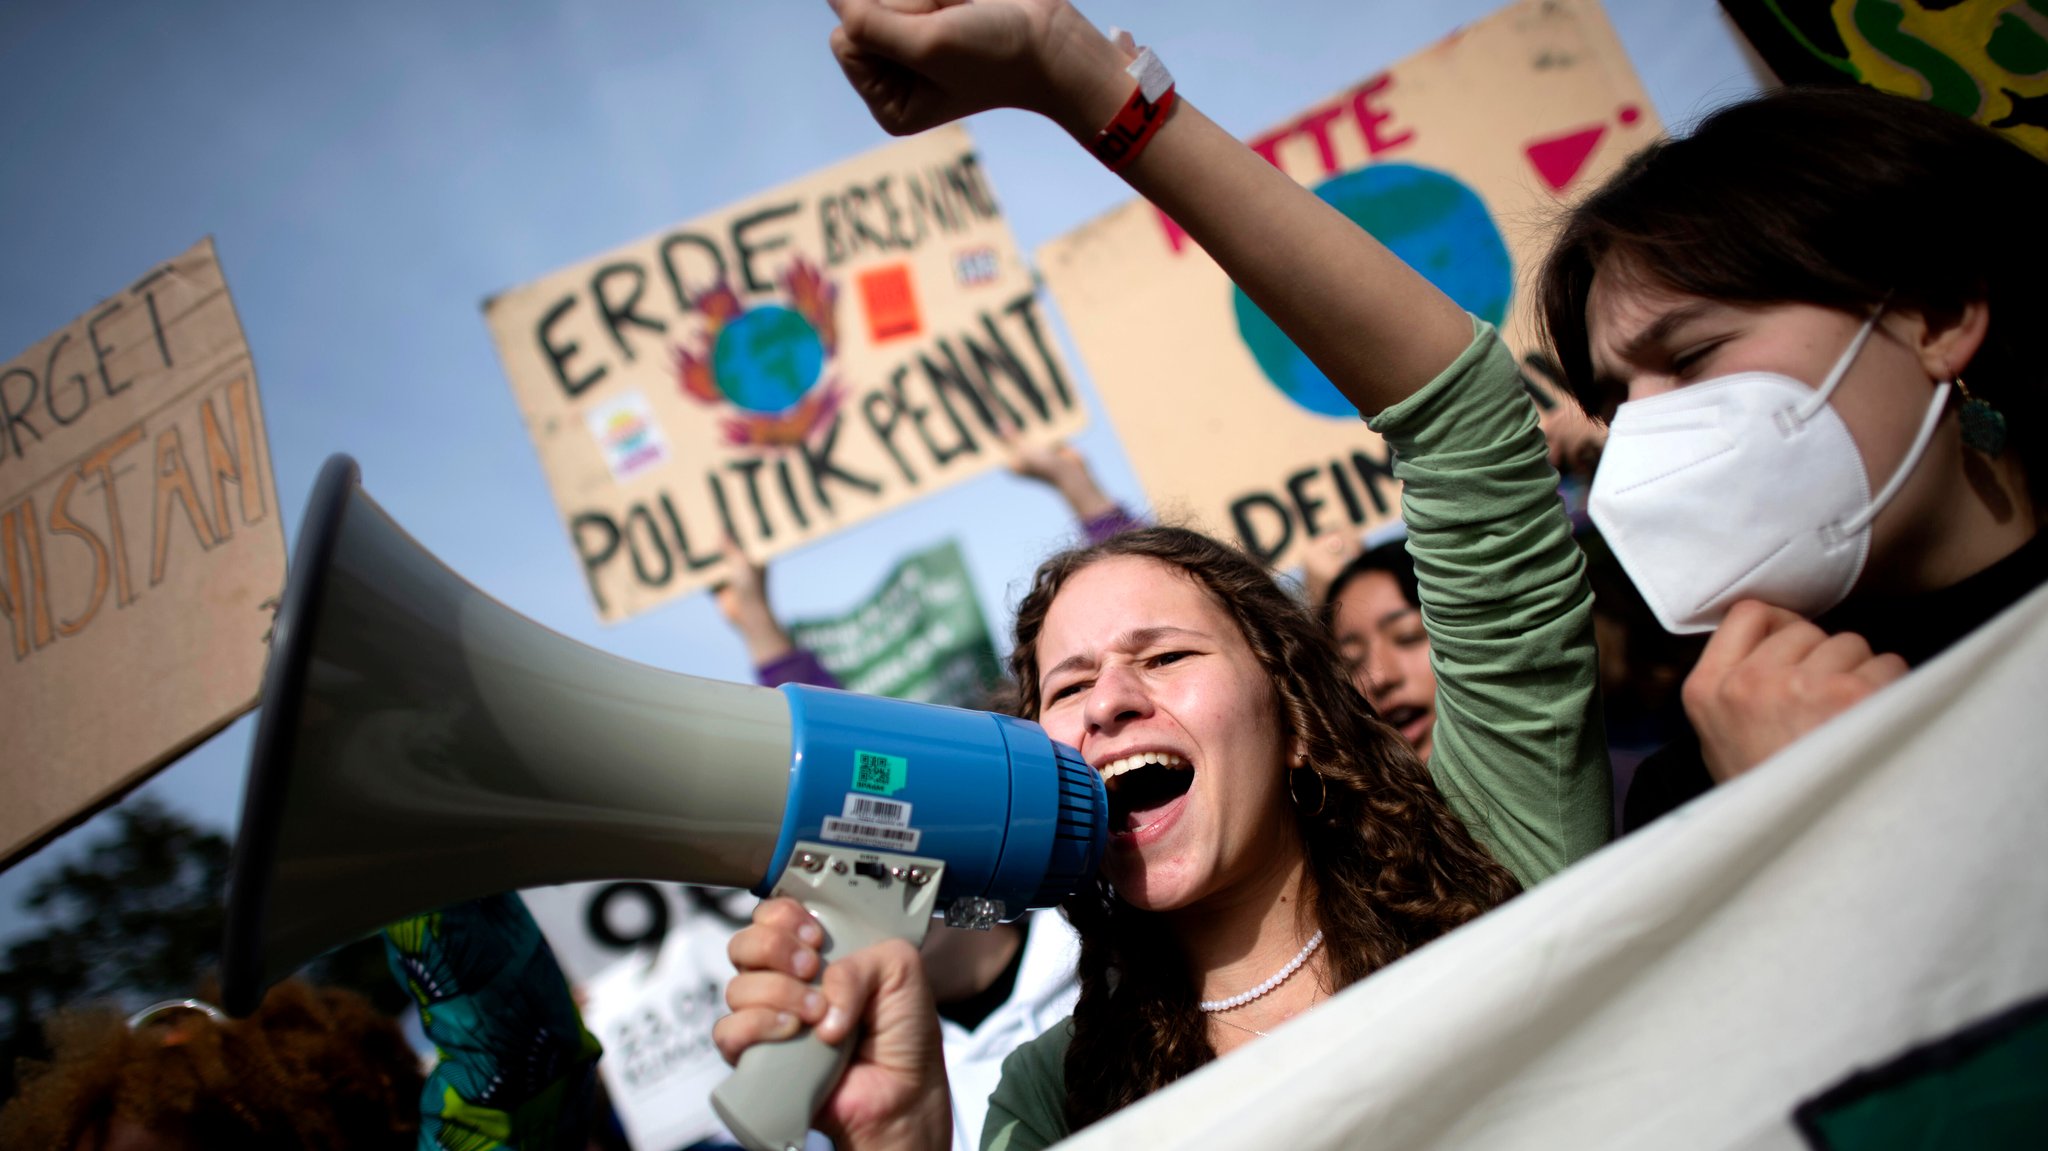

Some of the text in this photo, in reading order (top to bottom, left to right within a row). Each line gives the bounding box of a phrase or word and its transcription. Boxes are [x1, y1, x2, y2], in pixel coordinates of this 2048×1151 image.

[0, 264, 174, 462] RGET
[535, 201, 802, 397] ERDE
[571, 293, 1073, 613] POLITIK PENNT
